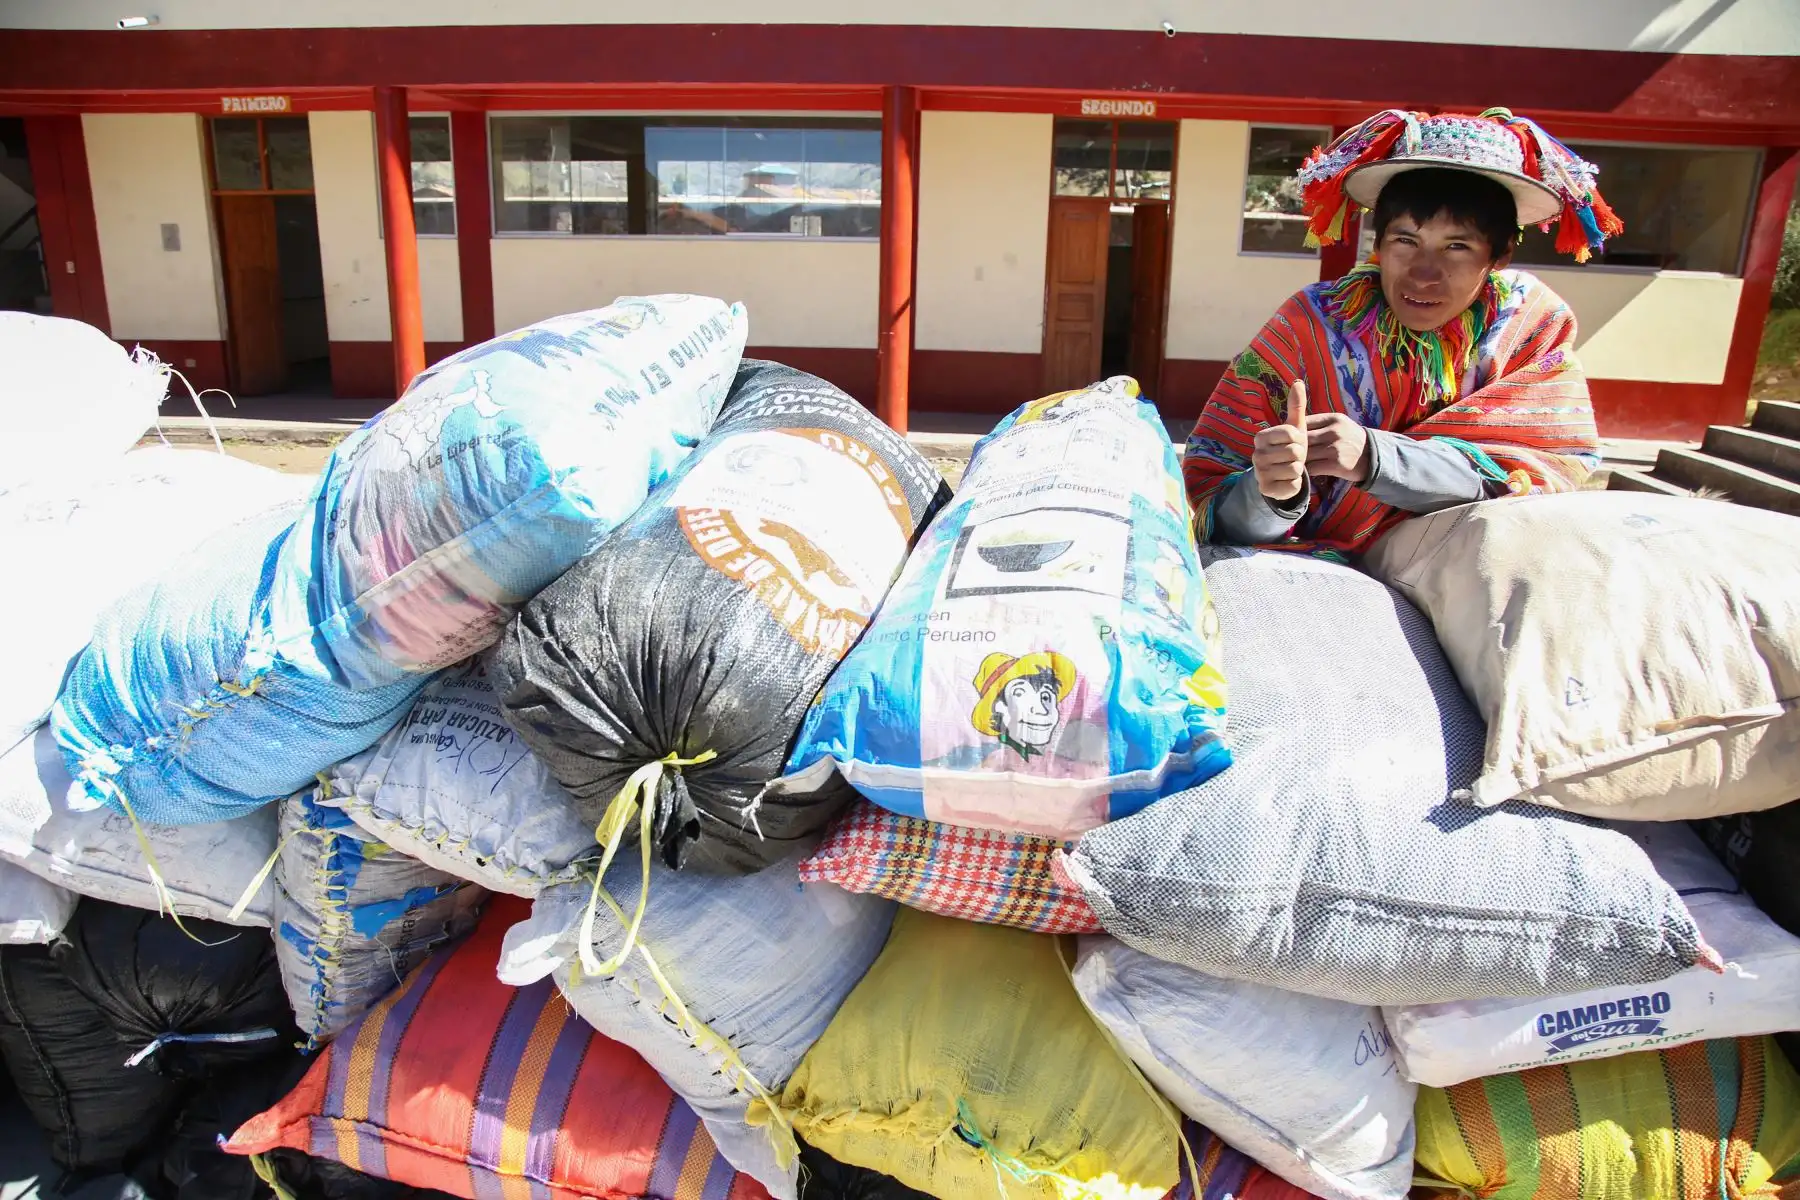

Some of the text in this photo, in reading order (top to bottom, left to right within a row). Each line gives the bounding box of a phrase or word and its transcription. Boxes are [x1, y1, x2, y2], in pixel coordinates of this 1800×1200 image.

[222, 95, 287, 112] PRIMERO
[1081, 99, 1155, 116] SEGUNDO
[916, 627, 996, 643] Peruano
[1536, 991, 1671, 1037] CAMPERO
[1585, 1021, 1640, 1042] Sur
[1578, 1046, 1608, 1058] por
[1618, 1041, 1634, 1051] el
